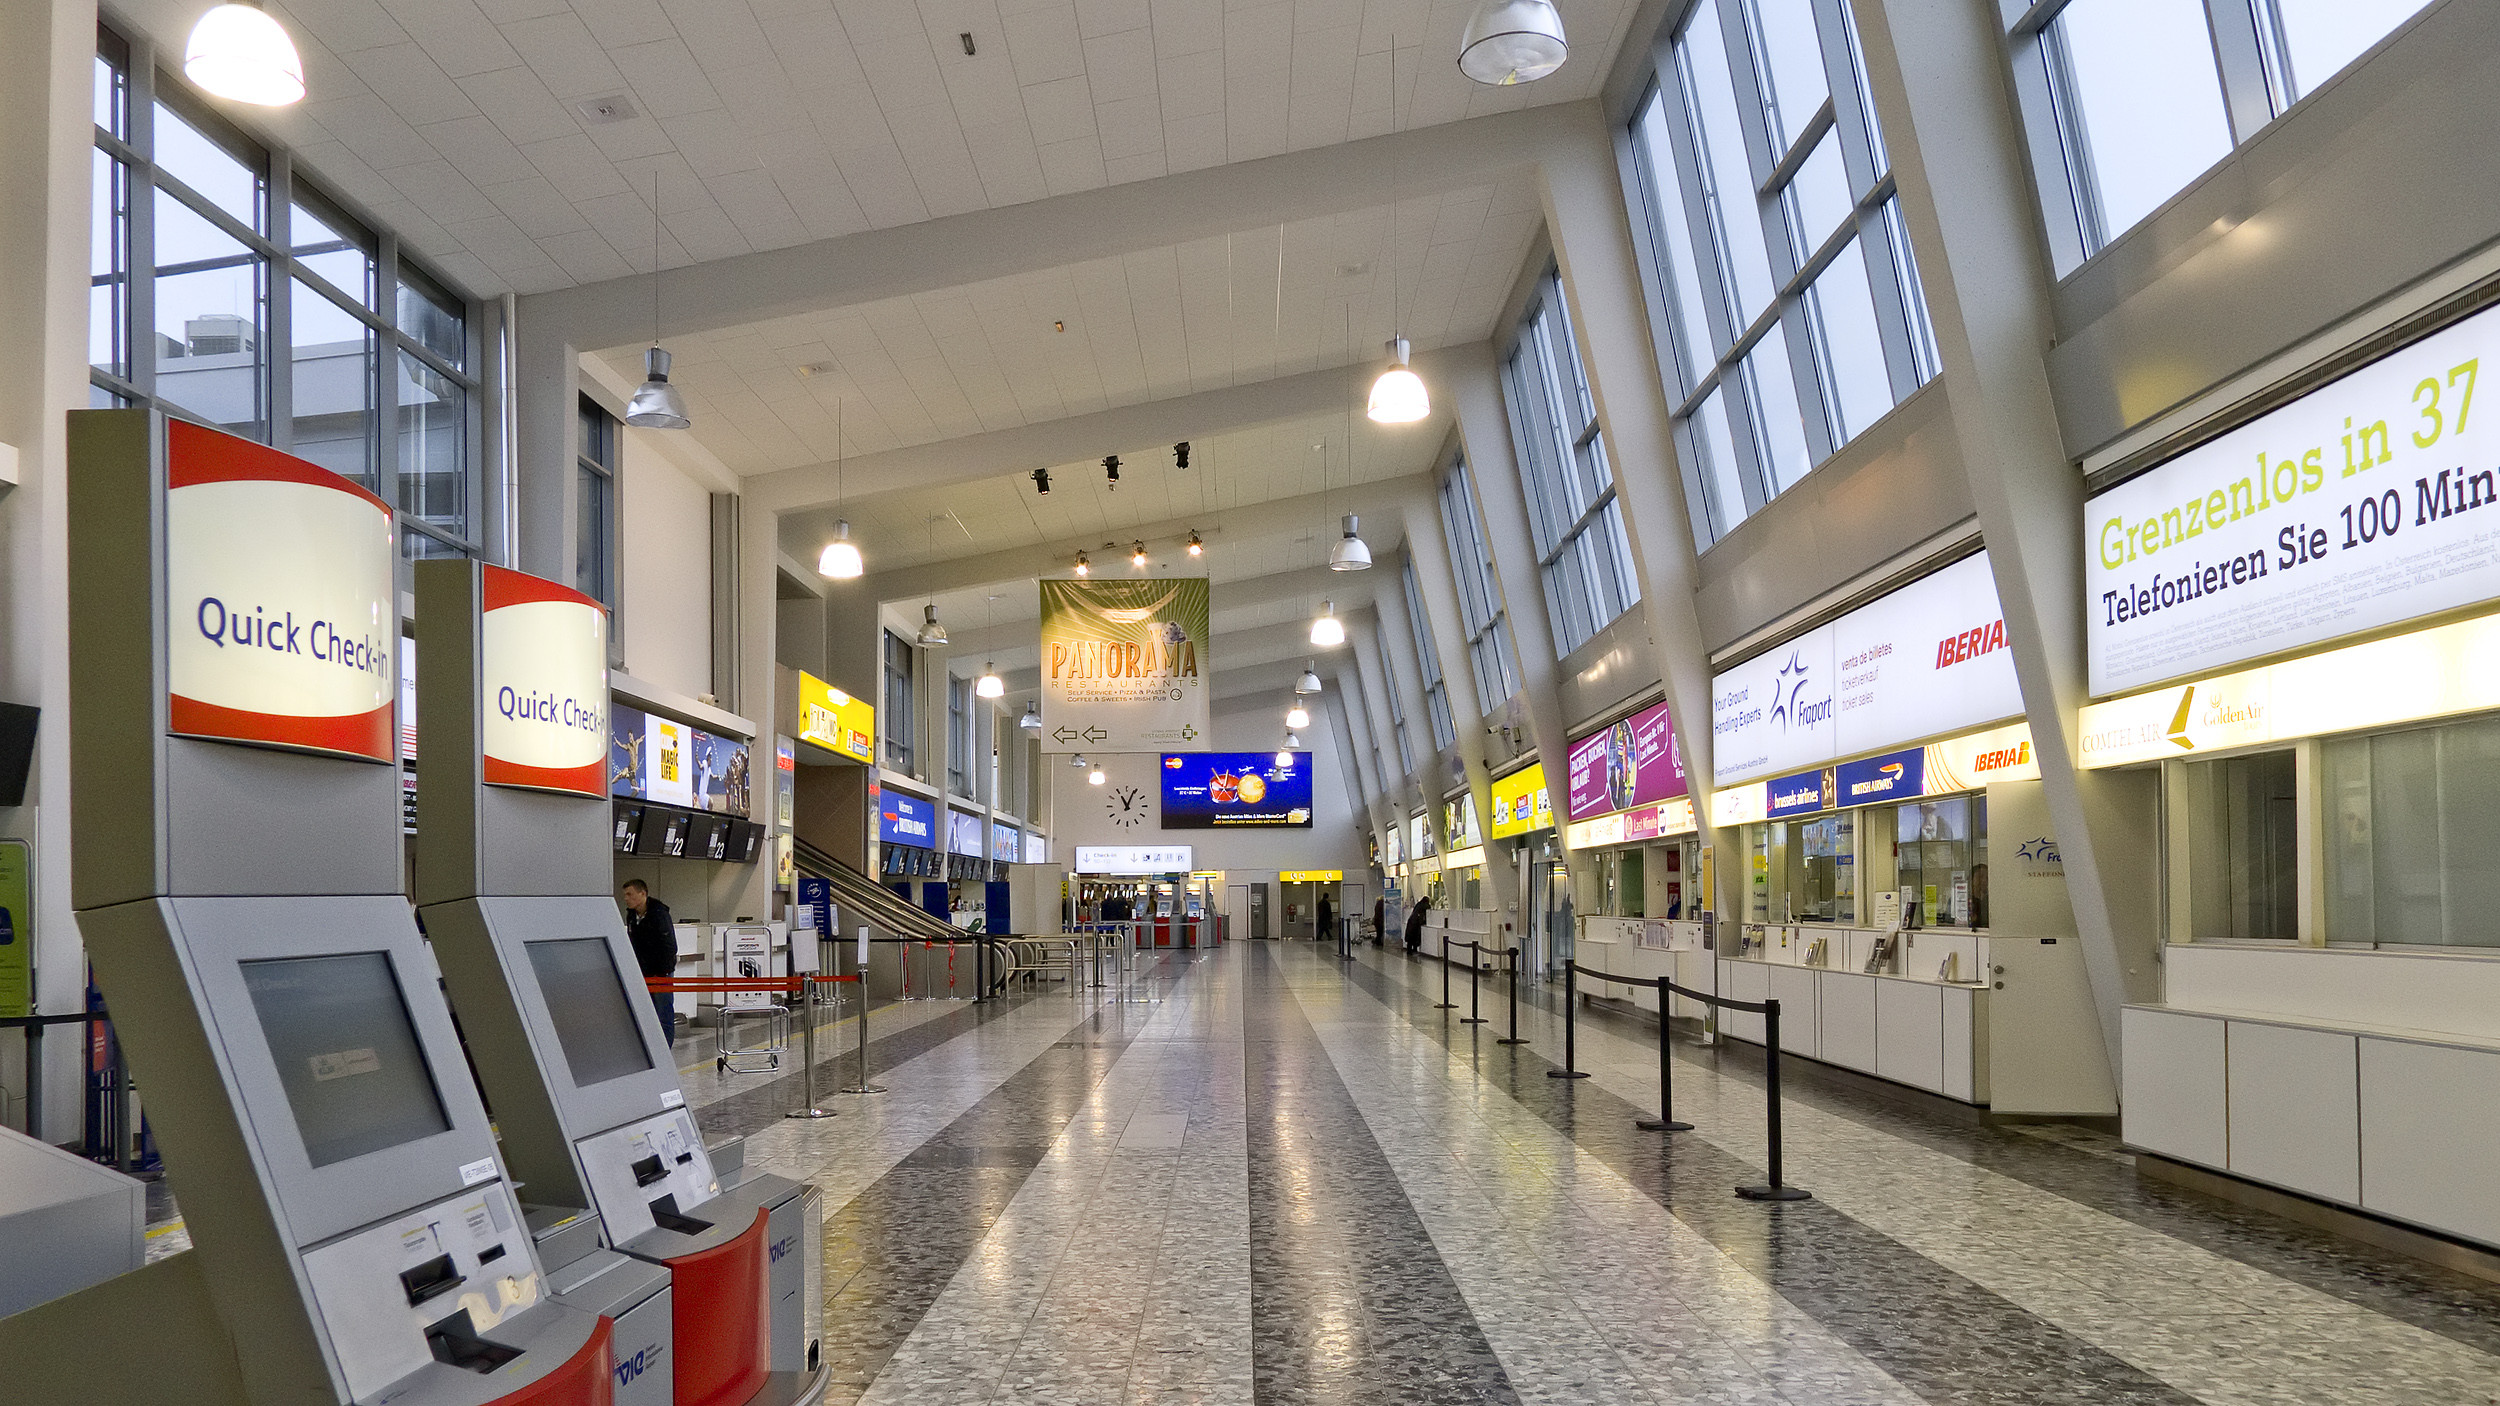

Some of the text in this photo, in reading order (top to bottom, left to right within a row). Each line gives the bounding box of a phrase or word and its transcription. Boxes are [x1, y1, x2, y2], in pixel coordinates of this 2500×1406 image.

[2100, 357, 2478, 570] Grenzenlos in 37
[2103, 466, 2500, 626] Telefonieren Sie 100 Min
[198, 597, 388, 680] Quick Check-in
[1936, 619, 2003, 670] IBERIA
[1051, 640, 1198, 678] PANORAMA
[1841, 642, 1892, 671] venta de billetes
[1052, 679, 1198, 688] RESTAURANTS
[1842, 665, 1879, 691] ticketverkauf
[499, 686, 559, 724] Quick
[1714, 684, 1748, 712] Your Ground
[1842, 691, 1874, 711] ticket sales
[1714, 708, 1761, 735] Handling Experts
[1798, 695, 1831, 730] Fraport
[2203, 702, 2264, 728] GoldenAir
[2082, 723, 2161, 753] COMTEL AIR
[660, 748, 679, 767] MAGIC
[1975, 748, 2017, 772] IBERIA
[661, 763, 672, 780] LIFE
[1774, 784, 1819, 809] brussels airlines
[1851, 781, 1871, 796] BRITISH
[1633, 818, 1643, 832] Last
[1643, 815, 1658, 831] Minute
[623, 833, 636, 852] 21
[672, 838, 684, 856] 22
[715, 842, 725, 859] 23
